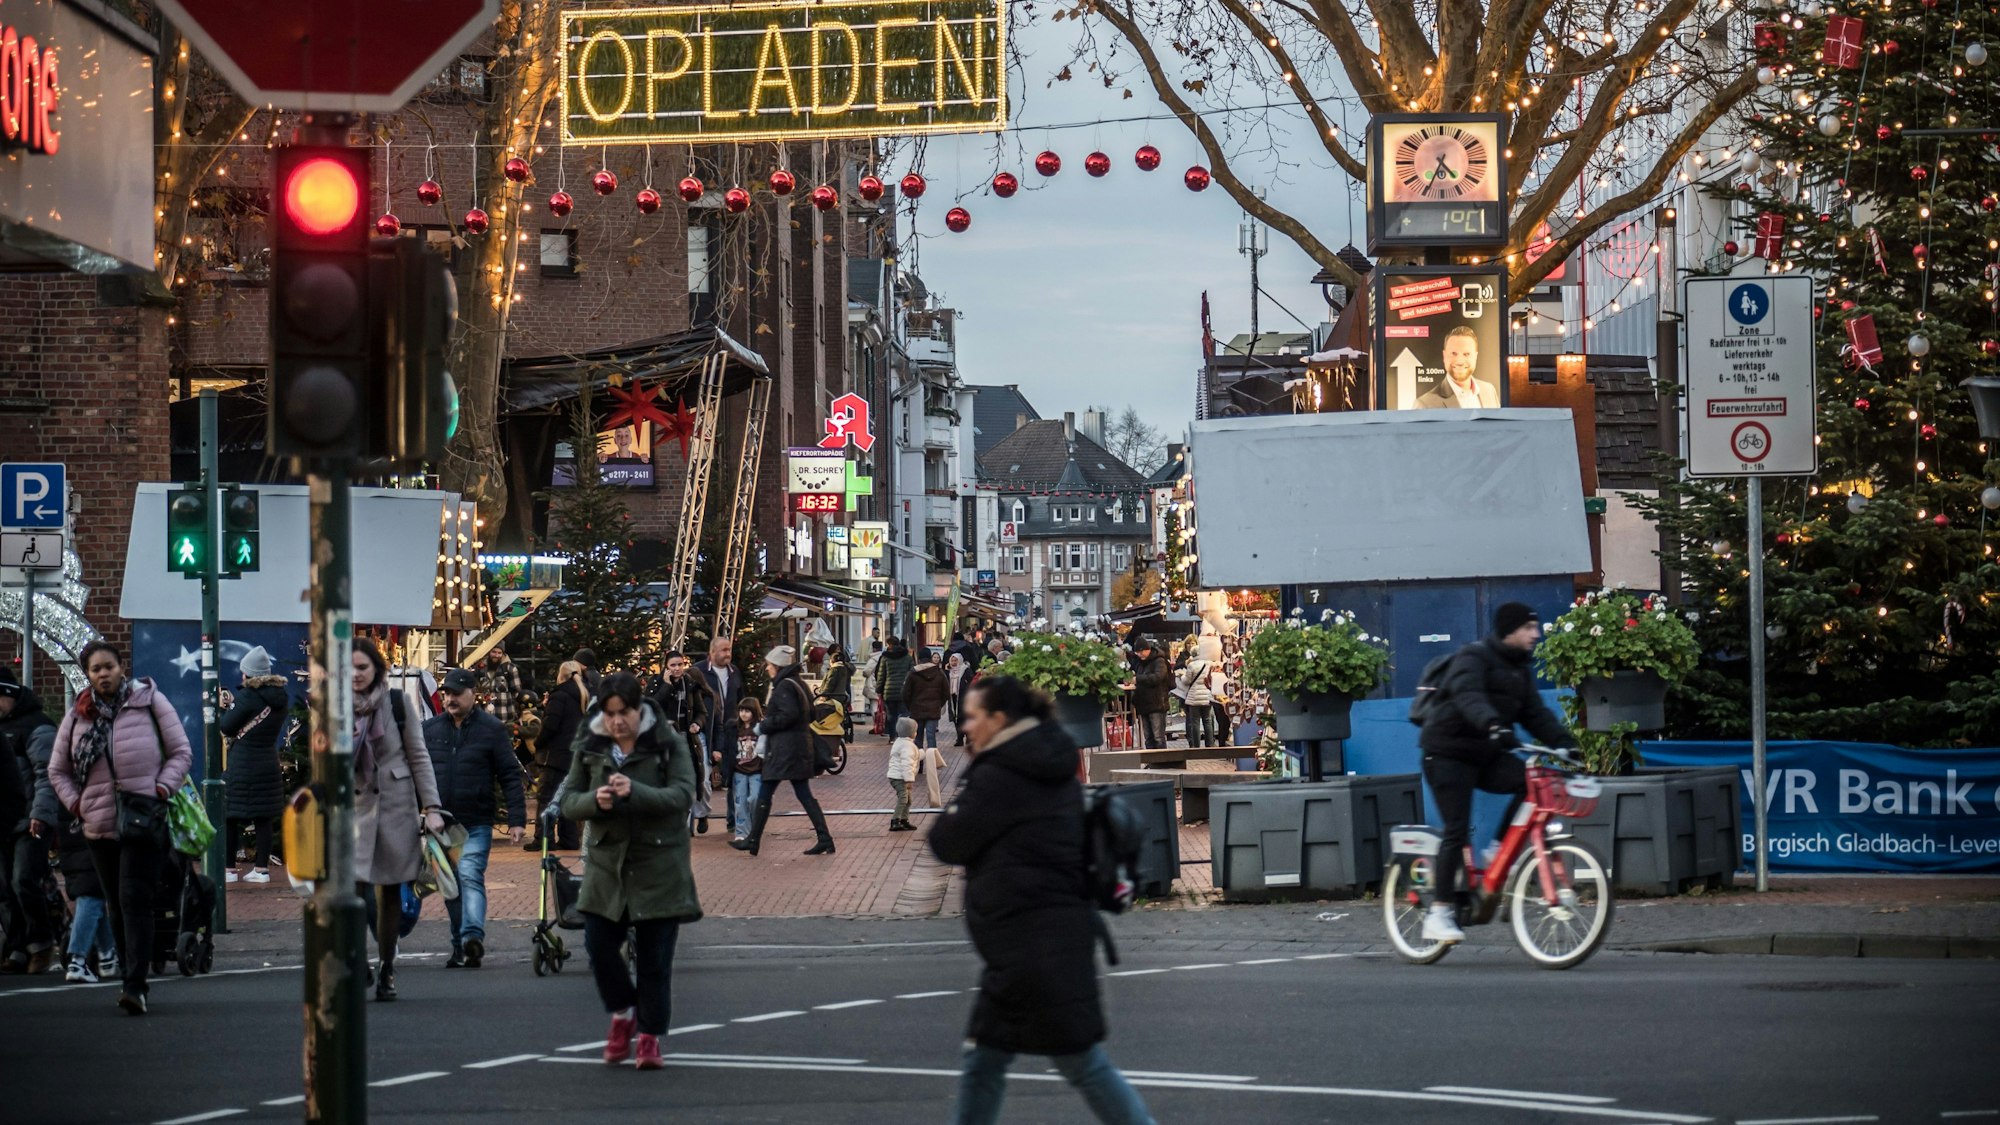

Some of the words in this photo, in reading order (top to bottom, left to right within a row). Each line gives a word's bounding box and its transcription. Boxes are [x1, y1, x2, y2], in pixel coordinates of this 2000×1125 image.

[578, 14, 983, 122] OPLADEN
[0, 20, 60, 155] one
[1405, 280, 1449, 293] Fachgeschäft
[1432, 290, 1459, 300] Internet
[1416, 304, 1450, 315] Mobilfunk
[1739, 326, 1760, 335] Zone
[1710, 338, 1745, 348] Radfahrer
[1747, 337, 1760, 347] frei
[1724, 350, 1773, 359] Lieferverkehr
[1733, 362, 1766, 372] werktags
[1719, 374, 1724, 383] 6
[1767, 372, 1780, 382] 14h
[1744, 385, 1757, 394] frei
[1711, 403, 1783, 413] Feuerwehrzufahrt
[790, 449, 845, 457] KIEFERORTHOPÄDIE
[16, 472, 50, 520] P
[801, 495, 838, 509] 16:32
[1310, 589, 1320, 604] 7
[1741, 769, 1819, 814] VR
[1838, 769, 1977, 815] Bank
[1742, 832, 1829, 857] Brgisch
